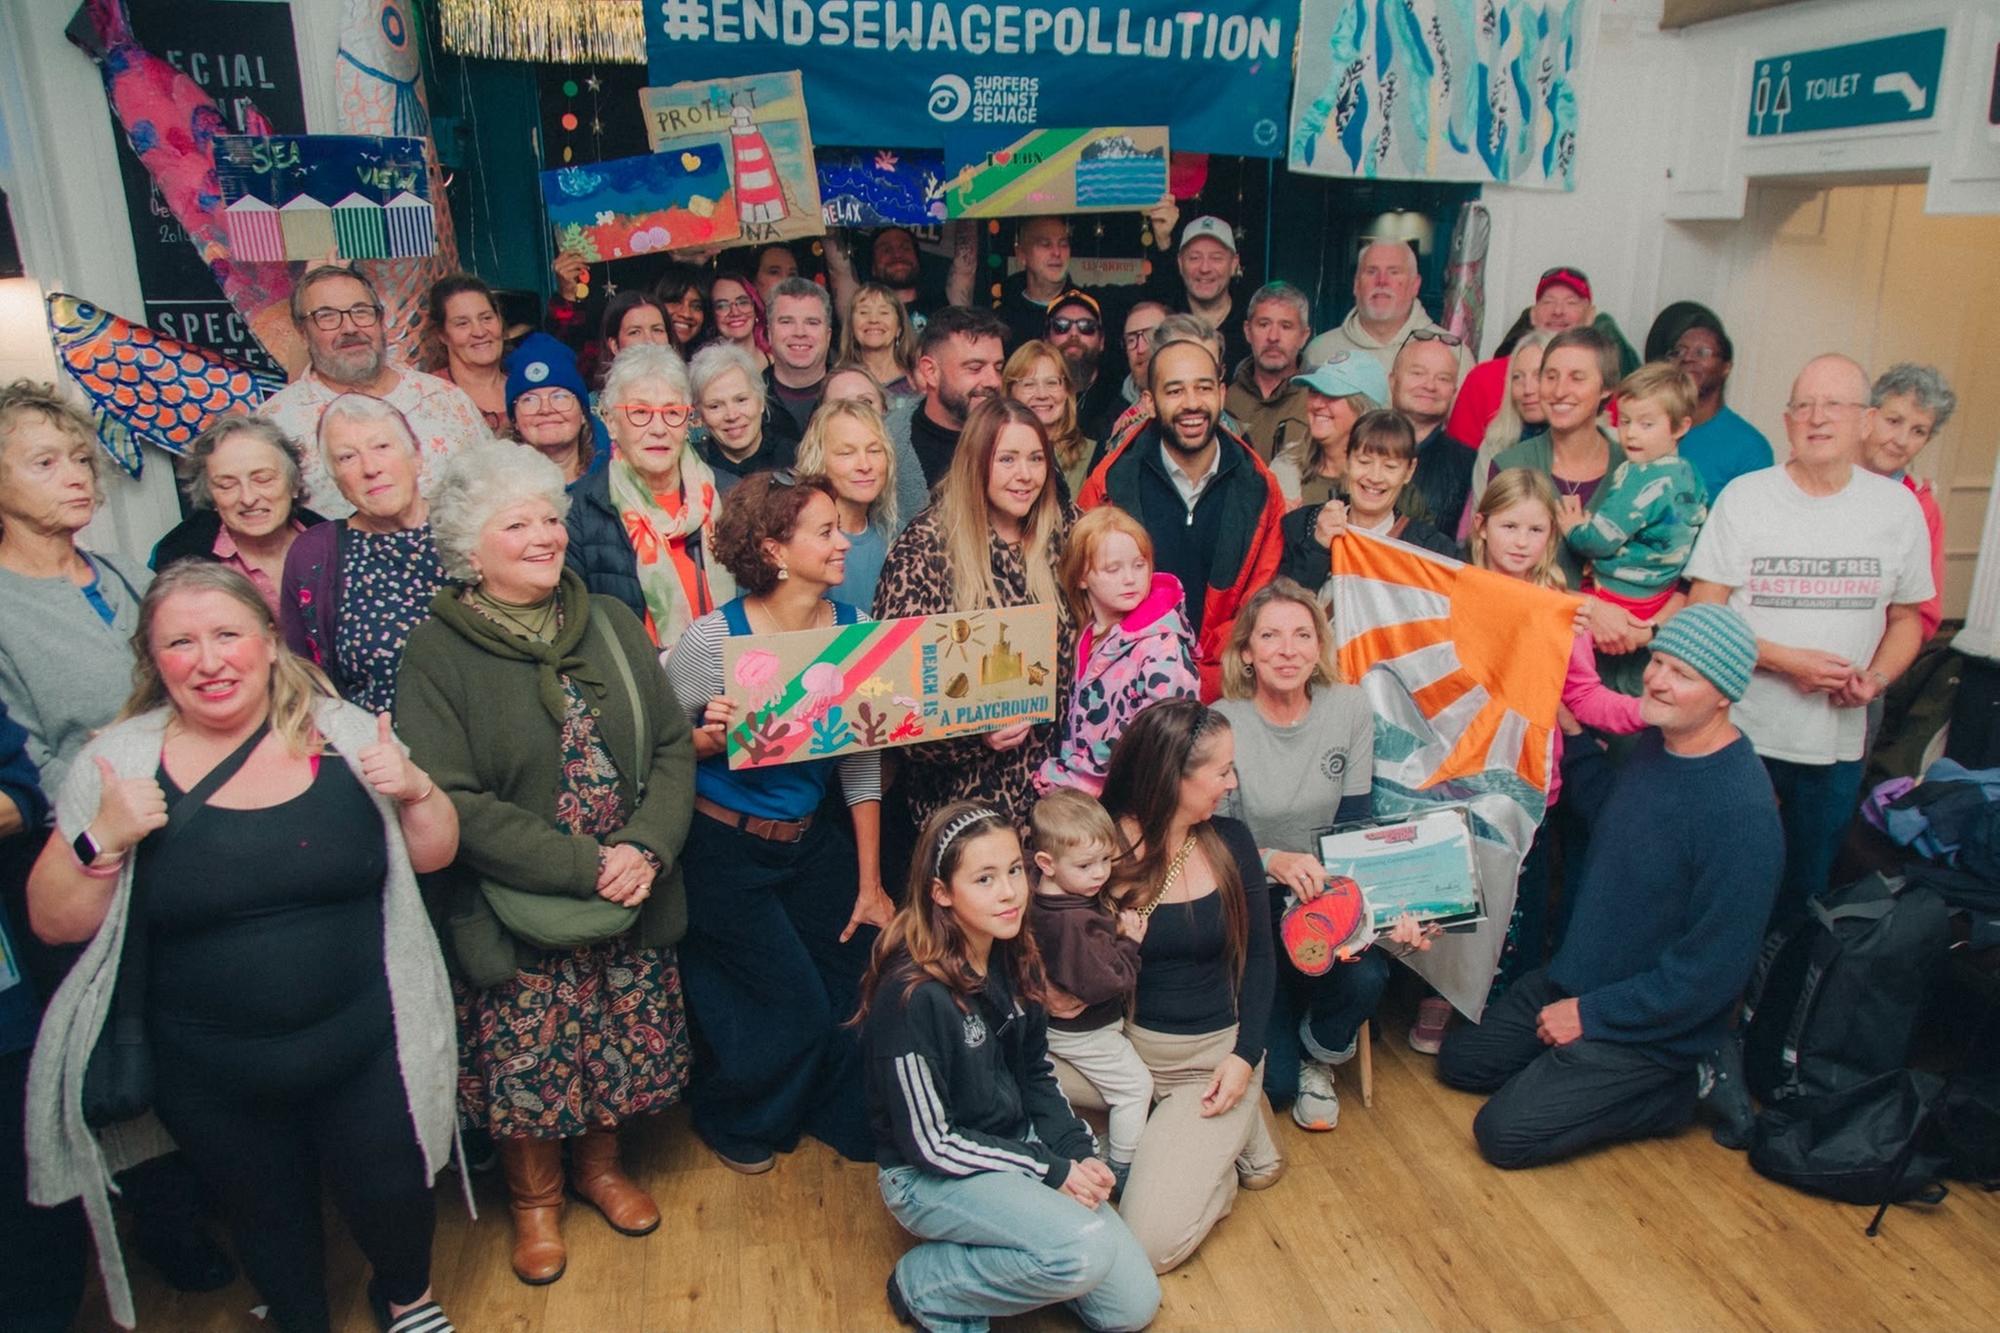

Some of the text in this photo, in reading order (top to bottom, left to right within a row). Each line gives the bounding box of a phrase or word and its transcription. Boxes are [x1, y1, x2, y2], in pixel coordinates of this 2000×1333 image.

[973, 75, 1039, 91] SURFERS
[1805, 73, 1861, 101] TOILET
[973, 90, 1038, 107] AGAINST
[973, 106, 1037, 123] SEWAGE
[252, 141, 300, 174] SEA
[356, 165, 417, 190] VIEW
[822, 200, 861, 225] RELAX
[1753, 559, 1880, 576] PLASTIC FREE
[1749, 577, 1881, 596] EASTBOURNE
[921, 643, 939, 716] BEACH IS
[939, 709, 950, 727] A
[956, 696, 1049, 724] PLAYGROUND
